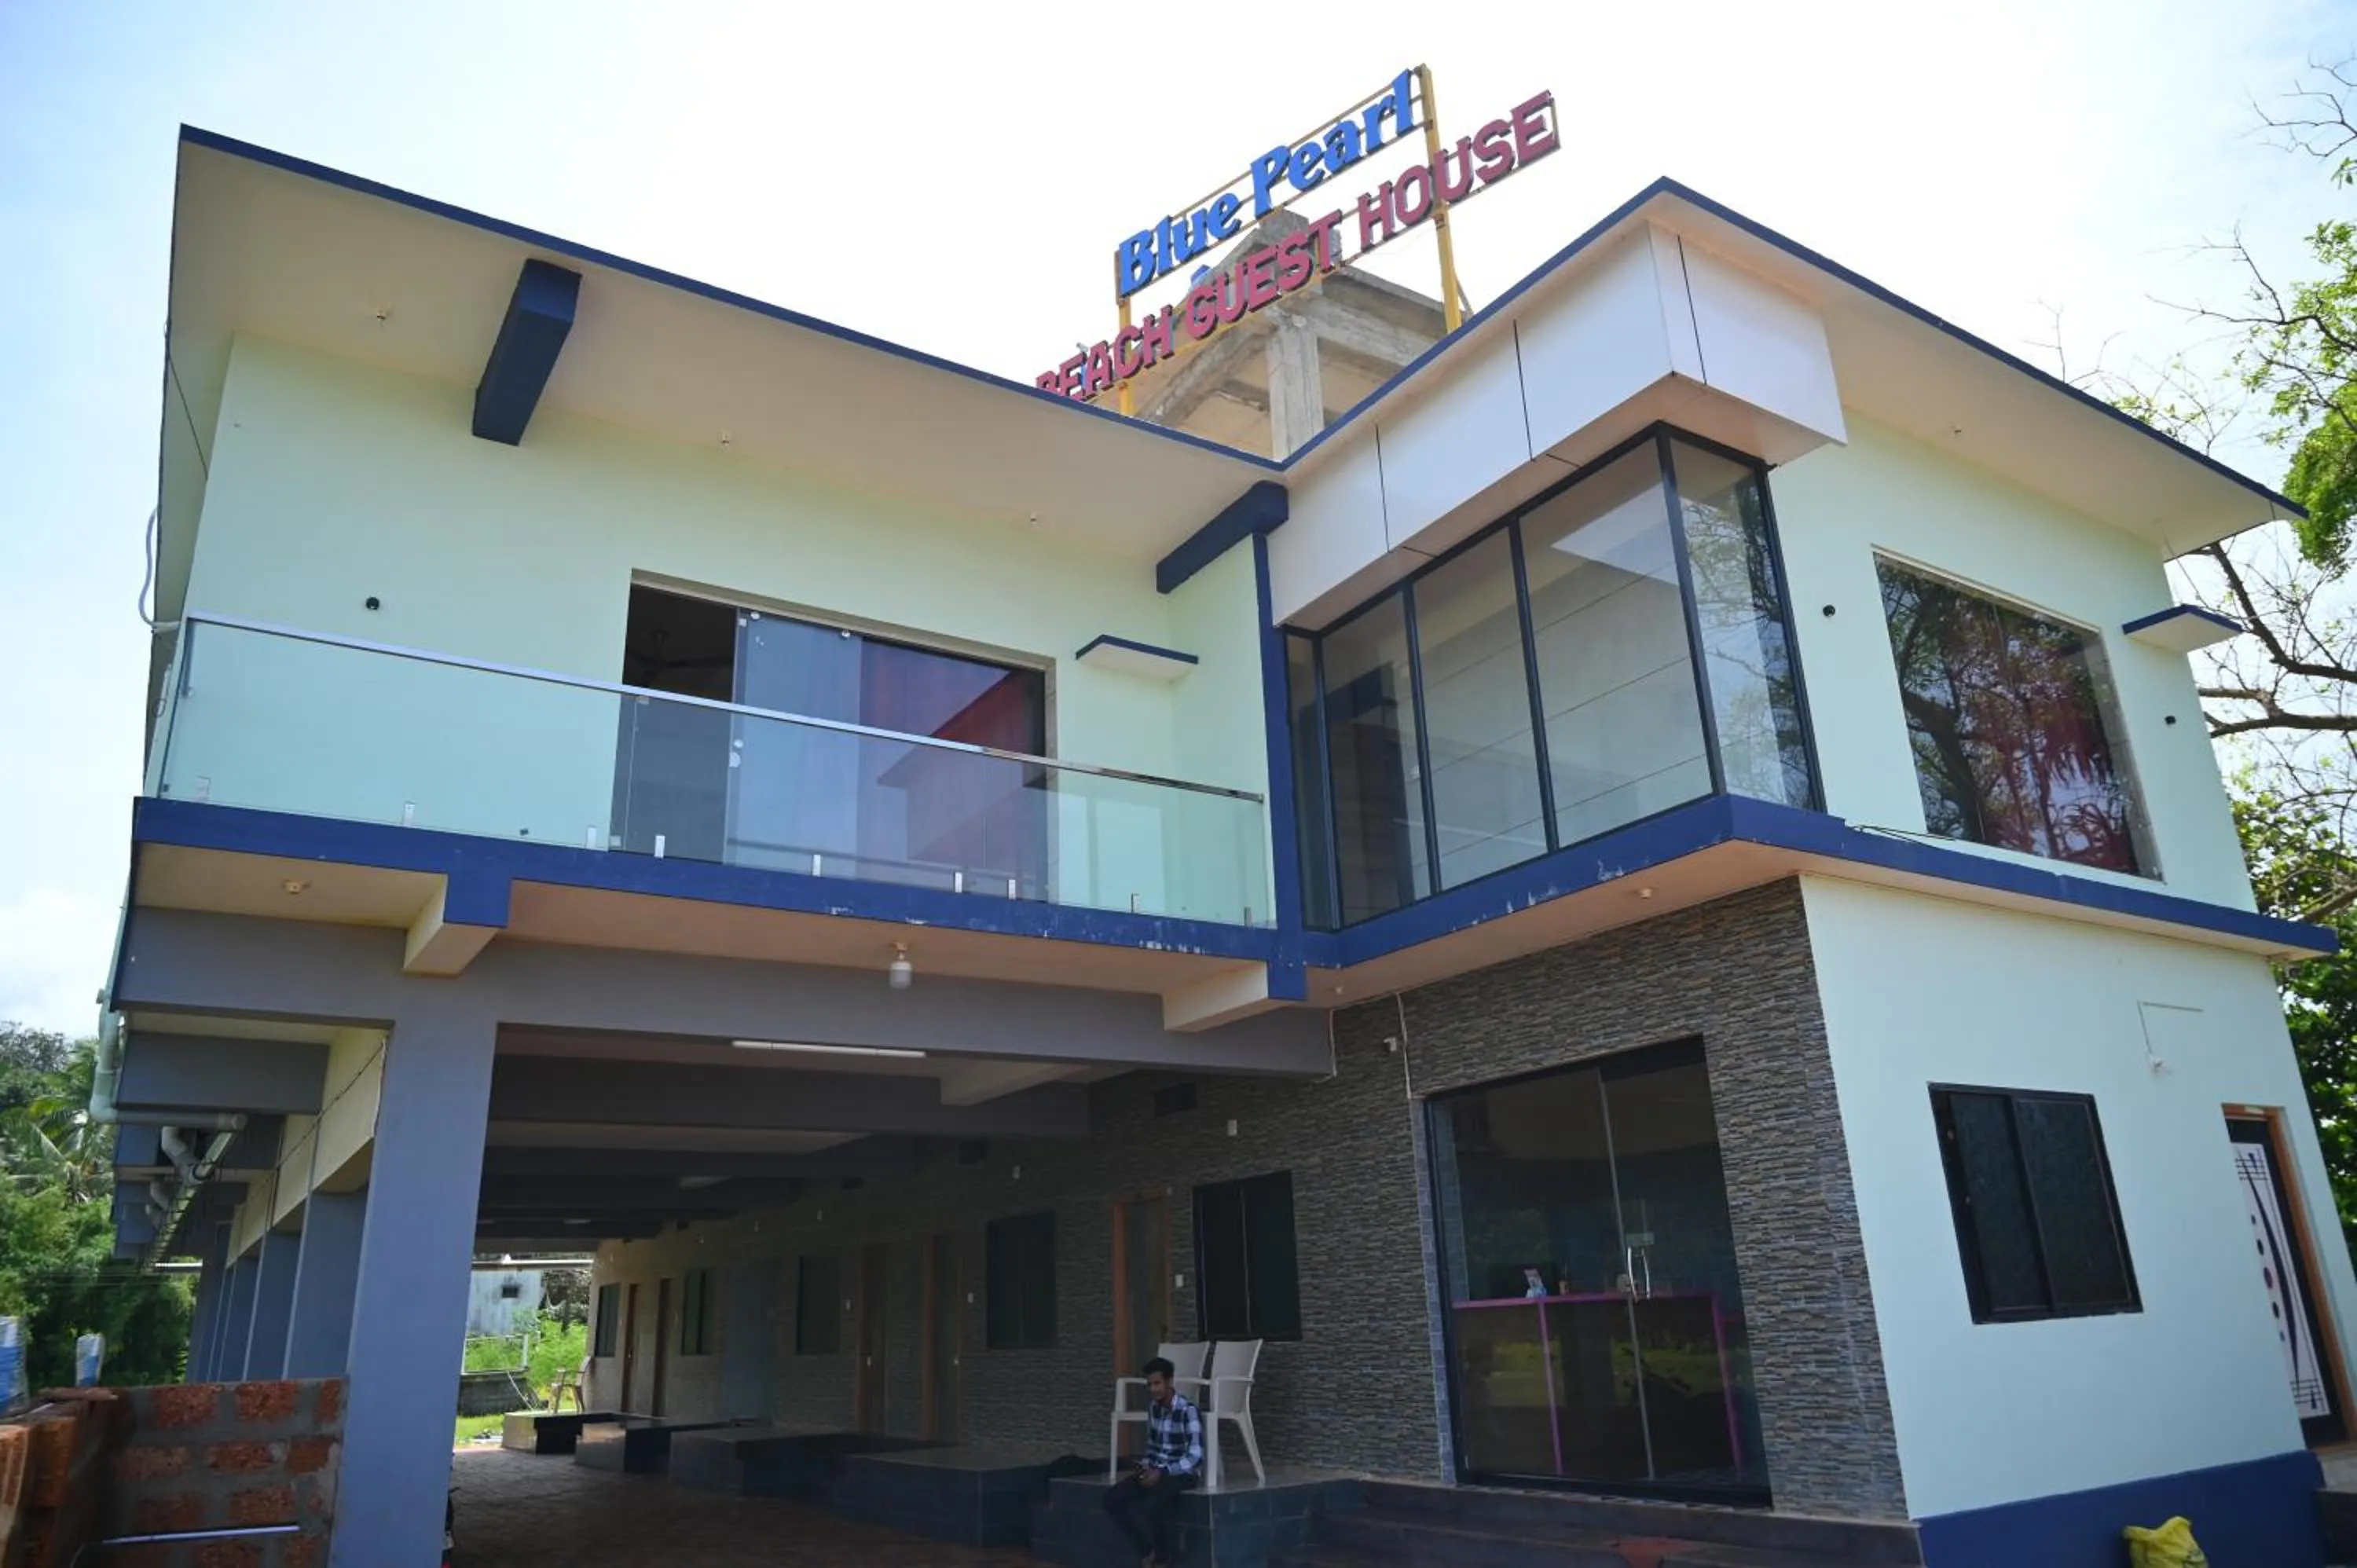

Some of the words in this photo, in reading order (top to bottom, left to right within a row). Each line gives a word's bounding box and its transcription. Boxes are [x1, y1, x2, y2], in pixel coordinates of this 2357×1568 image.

[1119, 192, 1242, 297] Blue
[1250, 68, 1413, 220] Pearl
[1186, 209, 1342, 339] GUEST
[1358, 90, 1558, 252] HOUSE
